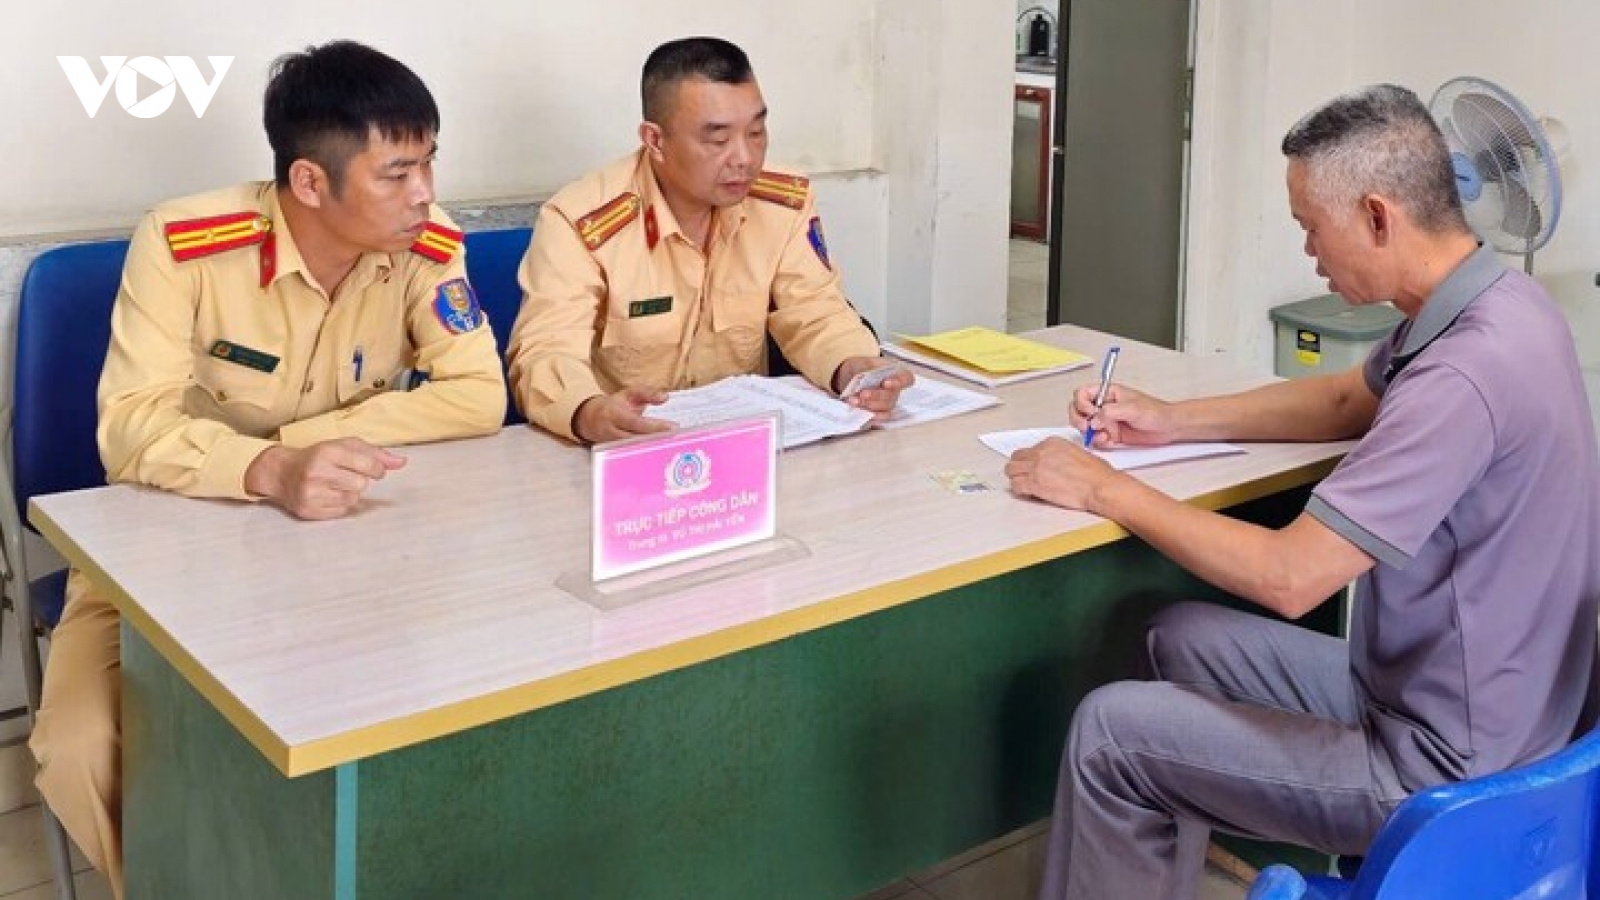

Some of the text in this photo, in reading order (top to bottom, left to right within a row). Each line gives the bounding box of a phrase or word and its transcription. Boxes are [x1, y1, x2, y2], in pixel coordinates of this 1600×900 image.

[616, 489, 758, 536] TRỰC TIẾP CÔNG DÂN
